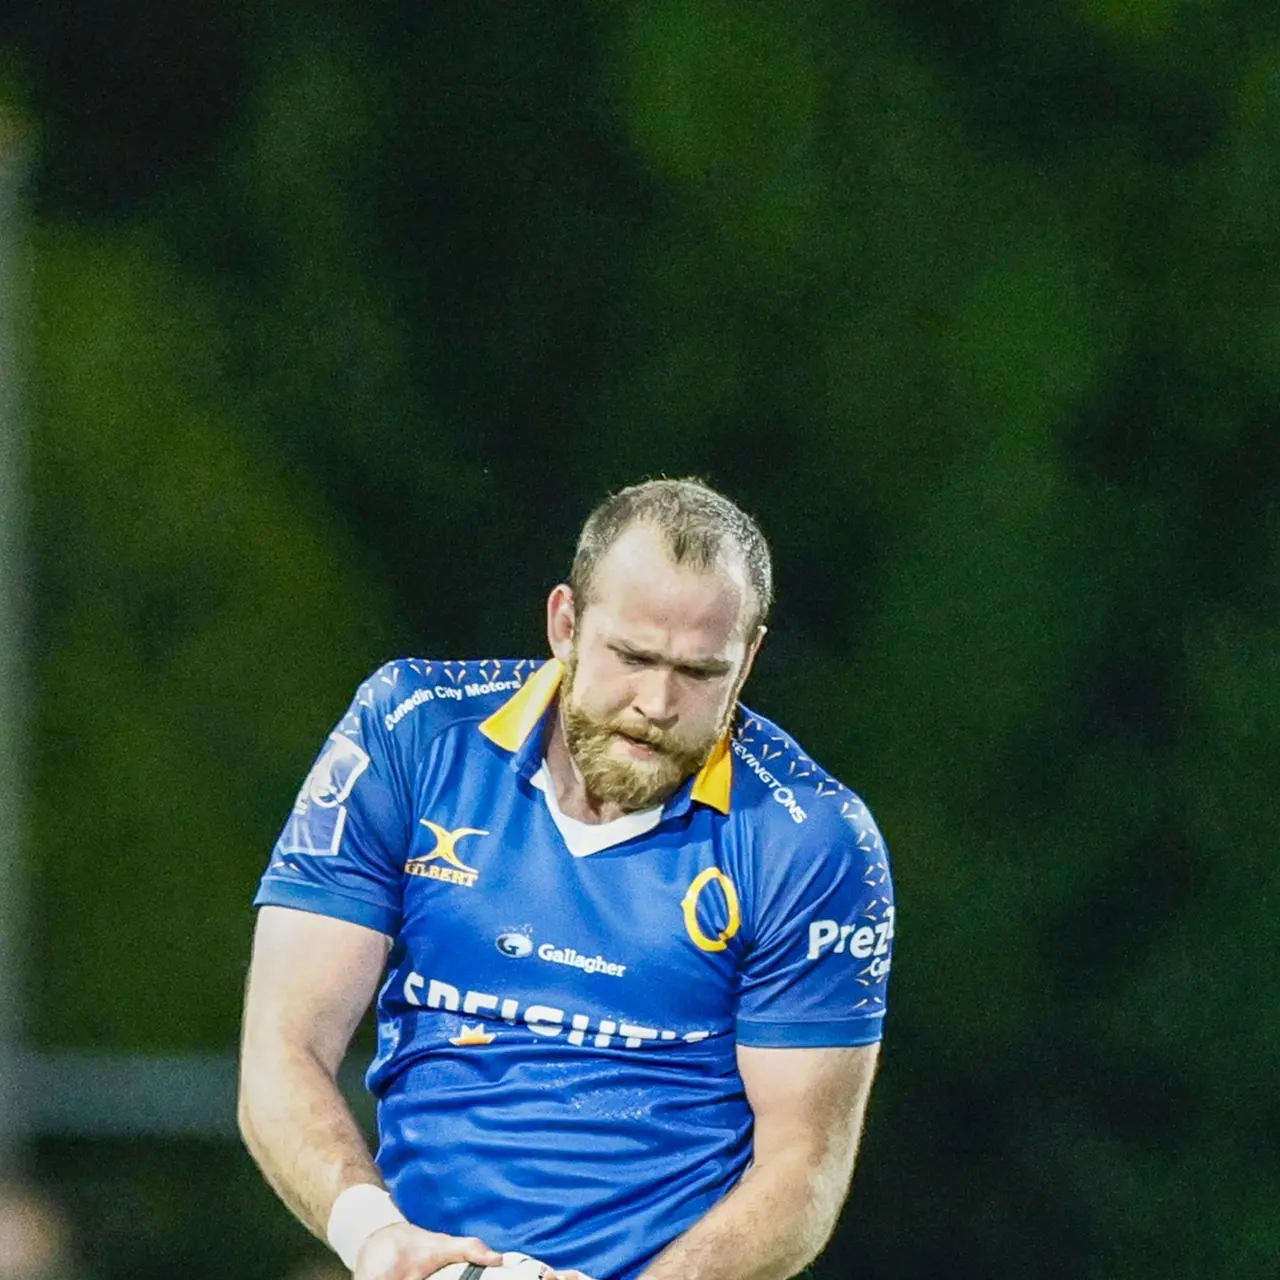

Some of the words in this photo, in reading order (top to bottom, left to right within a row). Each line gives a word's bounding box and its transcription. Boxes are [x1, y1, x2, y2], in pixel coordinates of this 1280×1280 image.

[435, 685, 463, 701] City
[464, 678, 522, 698] Motors
[537, 943, 627, 978] Gallagher
